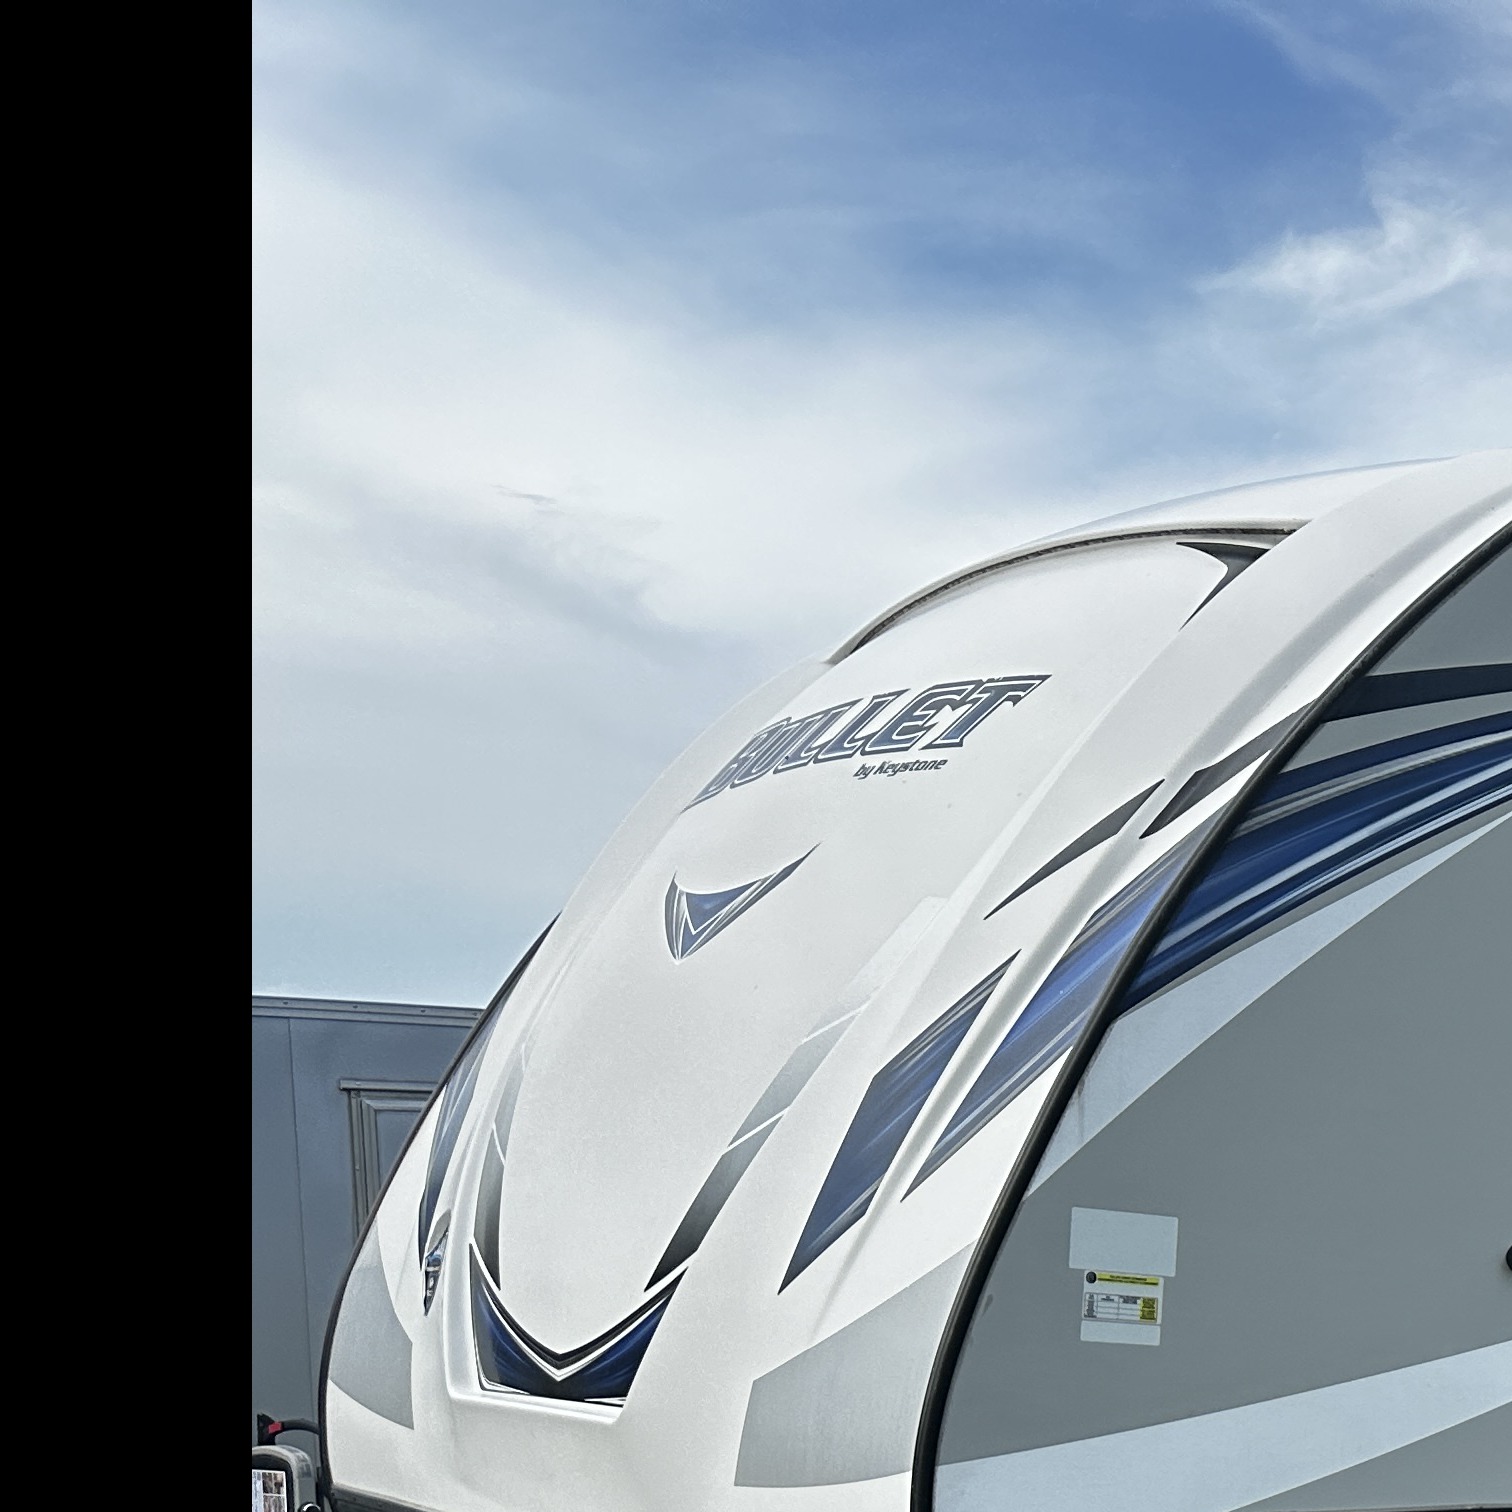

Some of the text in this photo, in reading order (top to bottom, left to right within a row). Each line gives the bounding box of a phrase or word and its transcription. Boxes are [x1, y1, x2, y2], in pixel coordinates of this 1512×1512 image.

[680, 674, 1053, 814] BULLET
[853, 759, 949, 780] by Keystone
